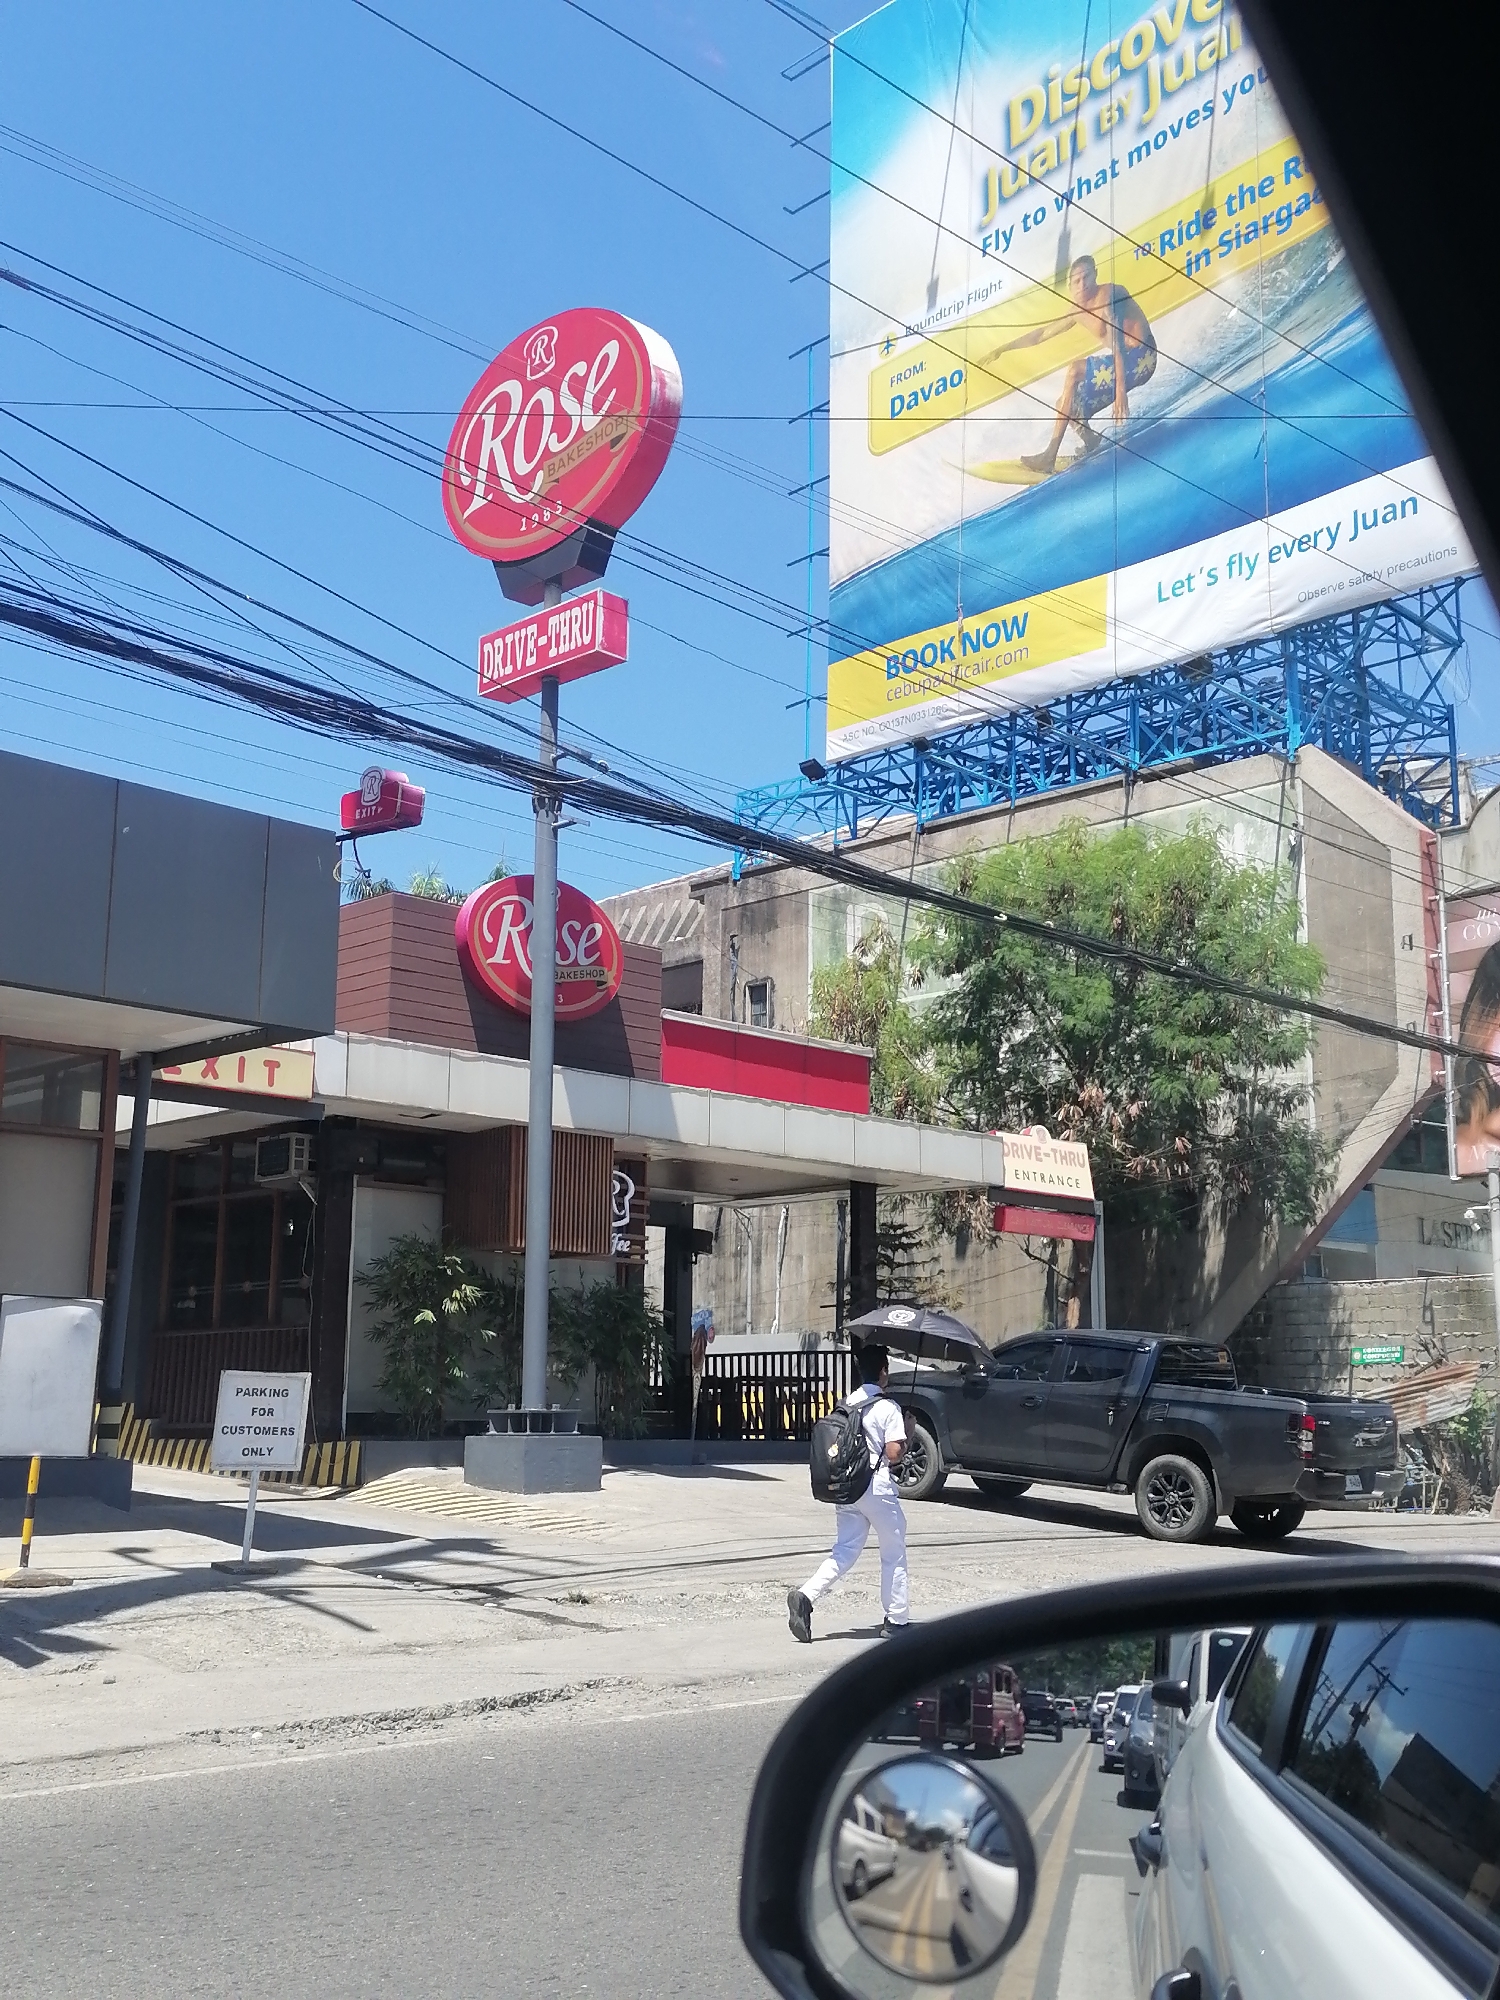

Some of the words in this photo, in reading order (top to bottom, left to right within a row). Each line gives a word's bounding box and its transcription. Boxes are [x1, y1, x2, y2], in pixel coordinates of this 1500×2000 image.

[981, 115, 1088, 226] Juan
[1099, 88, 1135, 135] BY
[981, 222, 1014, 258] Fly
[1022, 206, 1046, 233] to
[1054, 159, 1120, 213] what
[1128, 99, 1214, 169] moves
[1134, 242, 1155, 260] TO:
[1159, 207, 1217, 257] Ride
[1225, 175, 1275, 217] the
[1185, 247, 1211, 277] in
[905, 300, 964, 337] Roundtrip
[967, 279, 1003, 305] Flight
[890, 361, 927, 387] FROM:
[890, 369, 964, 419] Davao
[459, 339, 620, 523] Rose
[546, 415, 627, 478] BAKESHOP
[1157, 566, 1218, 603] Let's
[1226, 551, 1259, 581] fly
[1268, 521, 1341, 564] every
[1349, 496, 1418, 542] Juan
[1298, 580, 1345, 603] Observe
[1348, 569, 1384, 588] safety
[1387, 545, 1458, 579] precautions
[482, 599, 596, 686] DRIVE-THRU
[886, 635, 956, 681] BOOK
[961, 611, 1029, 657] NOW
[886, 646, 1029, 702] cebupacificair.com
[842, 729, 859, 743] ASC
[355, 805, 377, 819] EXIT
[483, 895, 603, 980] Rse
[1003, 1142, 1086, 1169] DRIVE-THRU
[1014, 1169, 1081, 1189] ENTRANCE
[235, 1387, 289, 1398] PARKING
[251, 1407, 275, 1417] FOR
[221, 1425, 296, 1436] CUSTOMERS
[241, 1446, 275, 1457] ONLY
